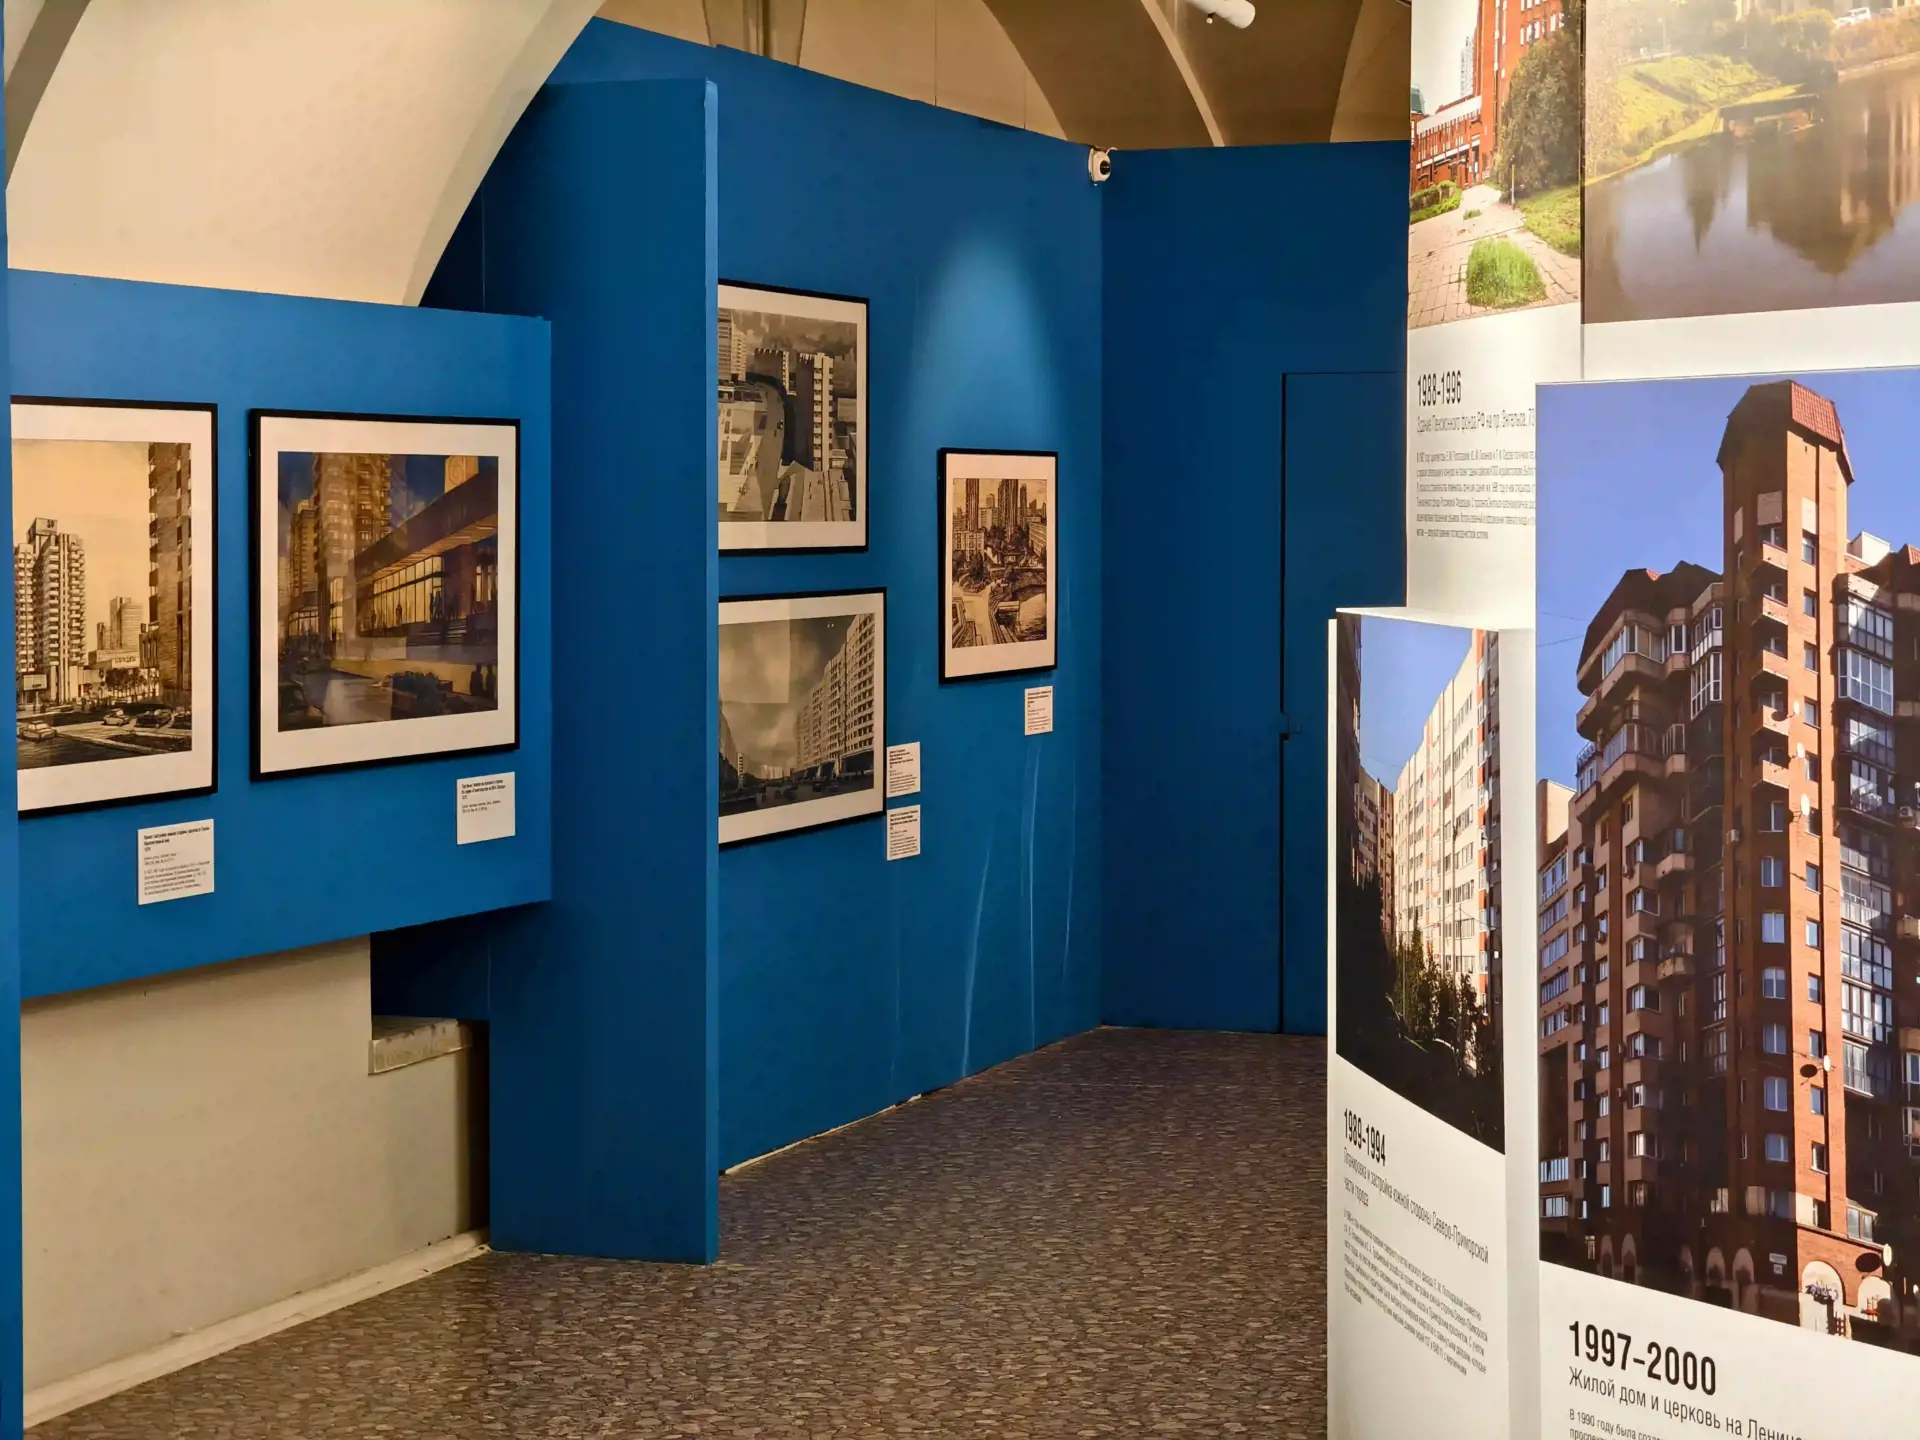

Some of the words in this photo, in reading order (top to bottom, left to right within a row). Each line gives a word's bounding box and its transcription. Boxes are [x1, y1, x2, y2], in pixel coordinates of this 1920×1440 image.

[1417, 369, 1462, 407] 1988-1996
[1343, 1108, 1386, 1166] 1989-1994
[1568, 1320, 1717, 1396] 1997-2000
[1569, 1366, 1615, 1399] Жилой
[1619, 1386, 1646, 1408] дом
[1651, 1395, 1659, 1411] и
[1663, 1398, 1721, 1429] церковь
[1726, 1416, 1742, 1436] на
[1569, 1408, 1575, 1420] В
[1577, 1411, 1595, 1427] 1990
[1596, 1419, 1614, 1436] году
[1616, 1423, 1636, 1440] была
